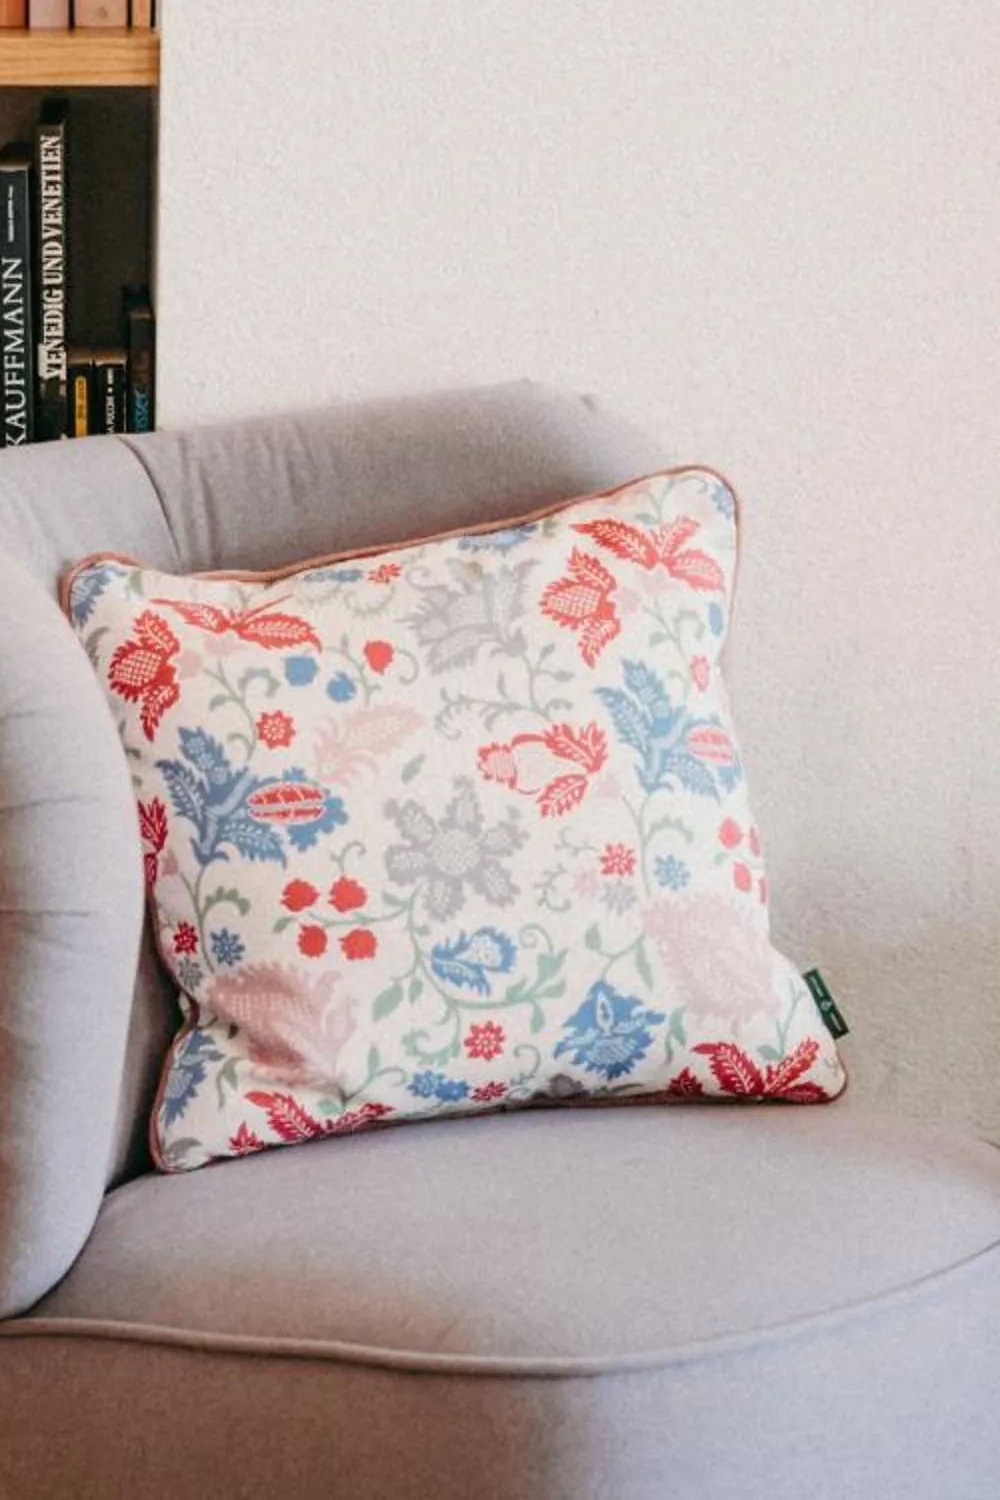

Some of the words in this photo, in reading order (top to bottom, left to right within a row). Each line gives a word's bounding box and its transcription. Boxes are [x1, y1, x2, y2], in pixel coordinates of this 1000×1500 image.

[40, 134, 62, 240] VENETIEN
[41, 241, 62, 286] UND
[1, 256, 27, 447] KAUFFMANN
[42, 288, 64, 378] VENEDIG
